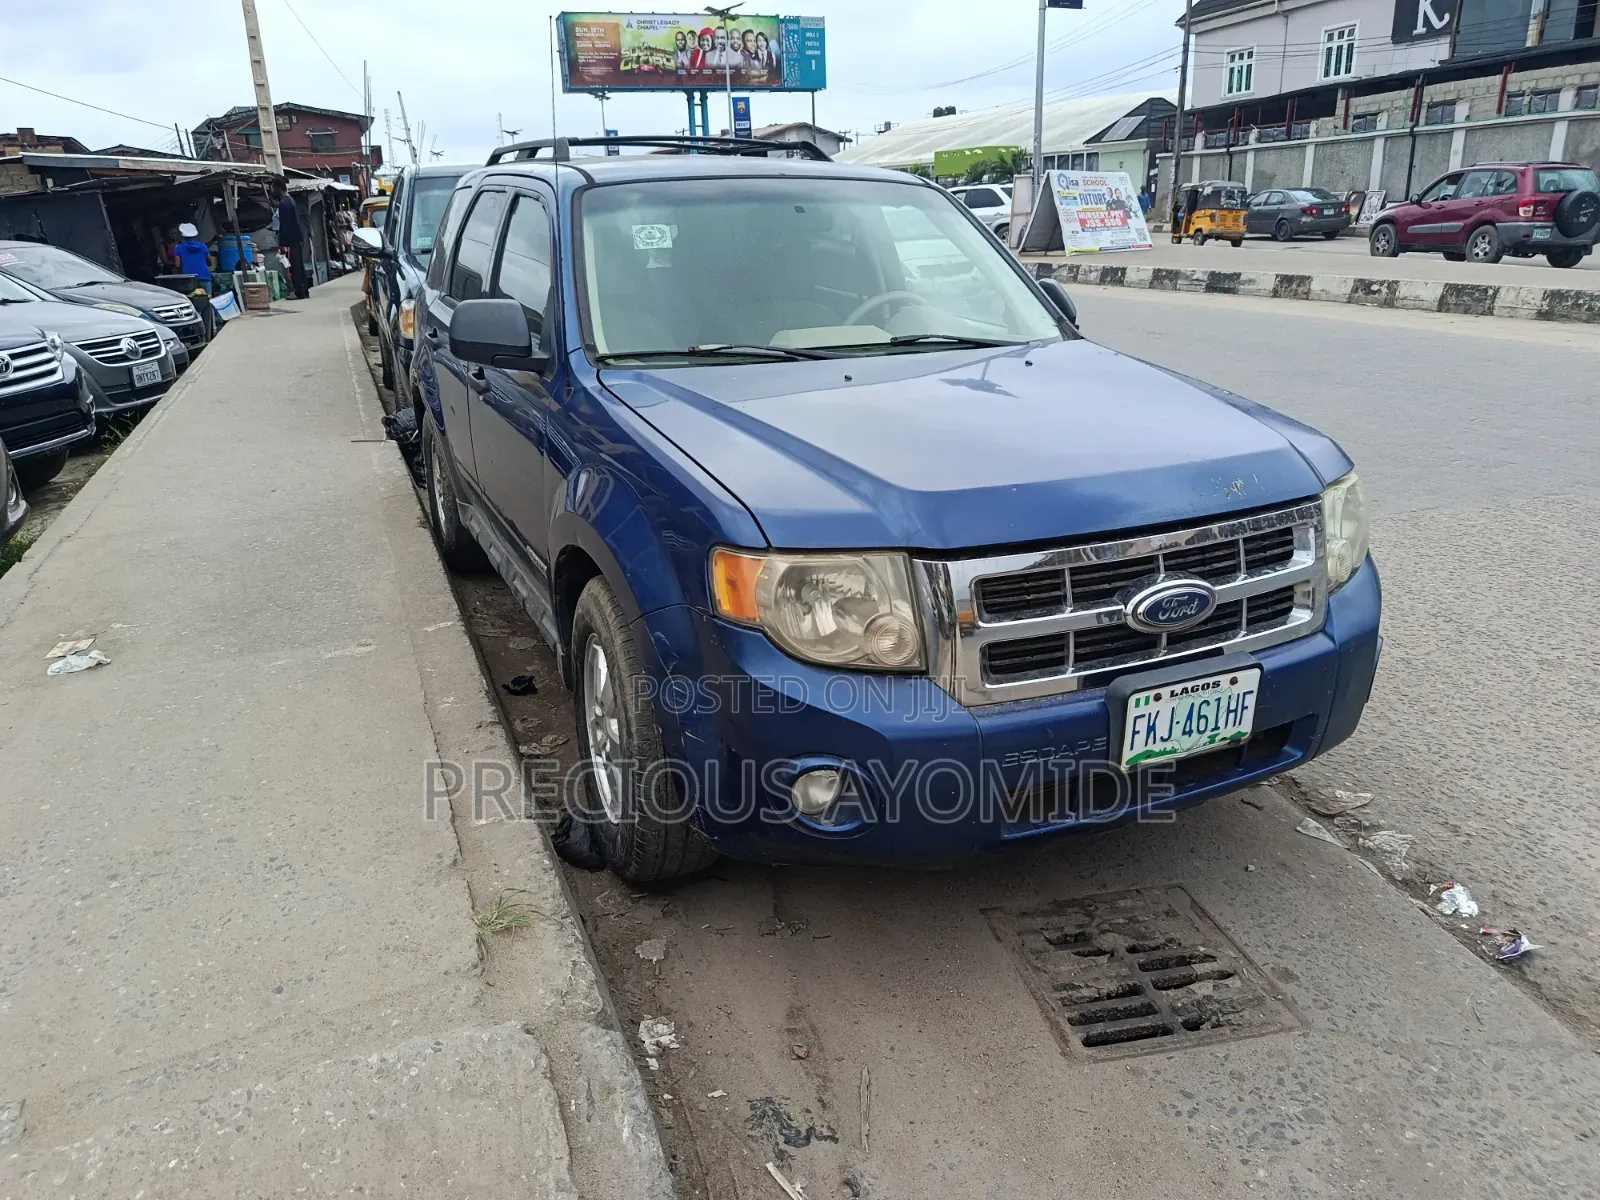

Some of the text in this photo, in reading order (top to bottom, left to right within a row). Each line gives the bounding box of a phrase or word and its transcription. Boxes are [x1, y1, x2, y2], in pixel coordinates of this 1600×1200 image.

[1412, 0, 1450, 36] K
[620, 56, 676, 71] GLORY
[1082, 179, 1108, 187] SCHOOL
[1079, 192, 1107, 206] FUTURE
[1104, 218, 1123, 227] SSS
[1158, 596, 1200, 621] Ford
[1169, 680, 1221, 698] LAGOS
[1001, 736, 1108, 768] ESCAPE
